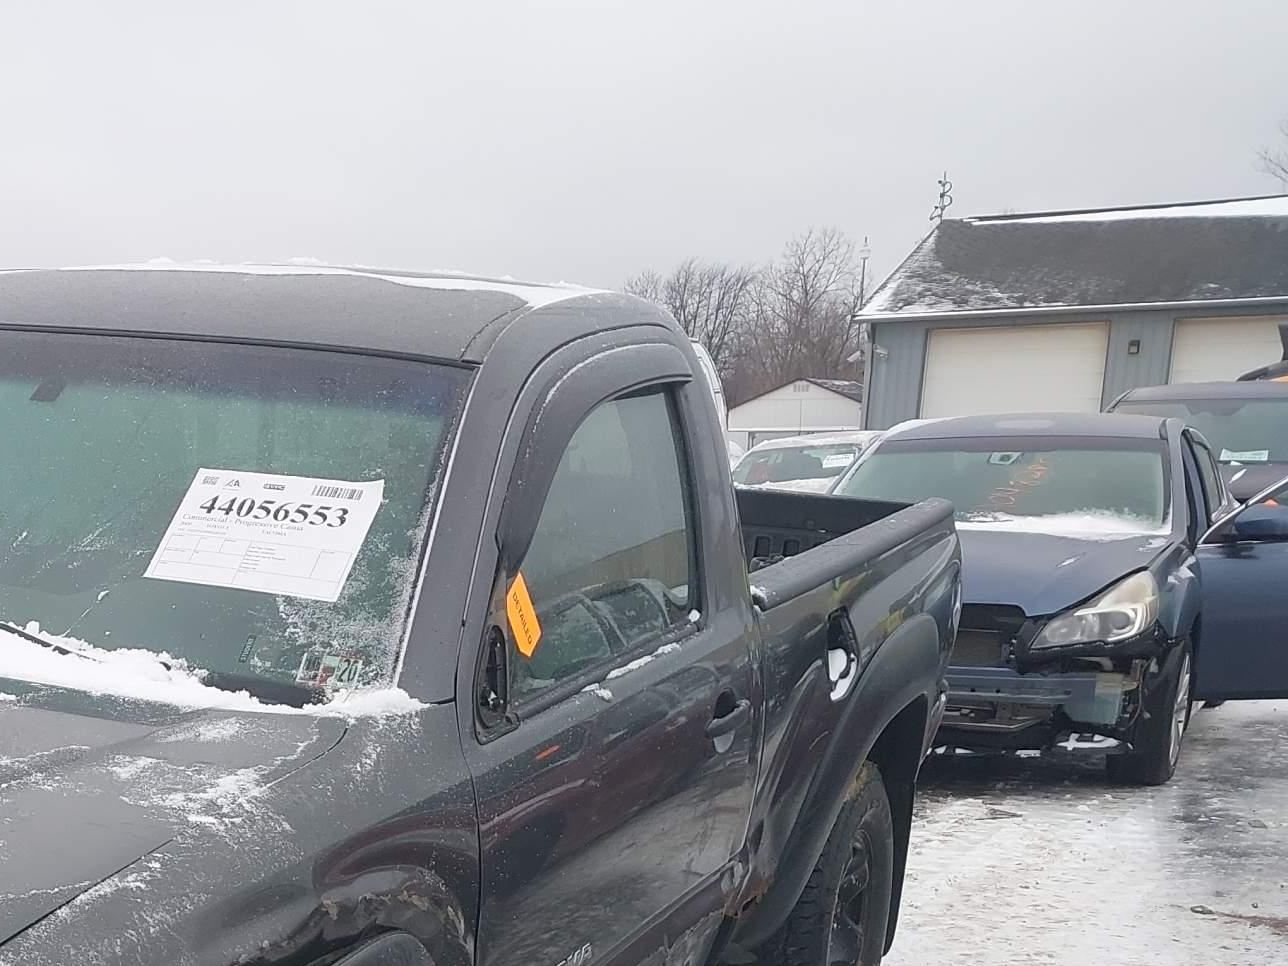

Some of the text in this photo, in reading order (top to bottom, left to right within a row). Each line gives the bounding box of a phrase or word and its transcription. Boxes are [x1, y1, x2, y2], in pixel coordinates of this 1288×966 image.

[182, 513, 229, 524] Commercial
[199, 494, 350, 528] 44056553
[512, 591, 533, 645] DETAILED
[337, 658, 359, 682] 20
